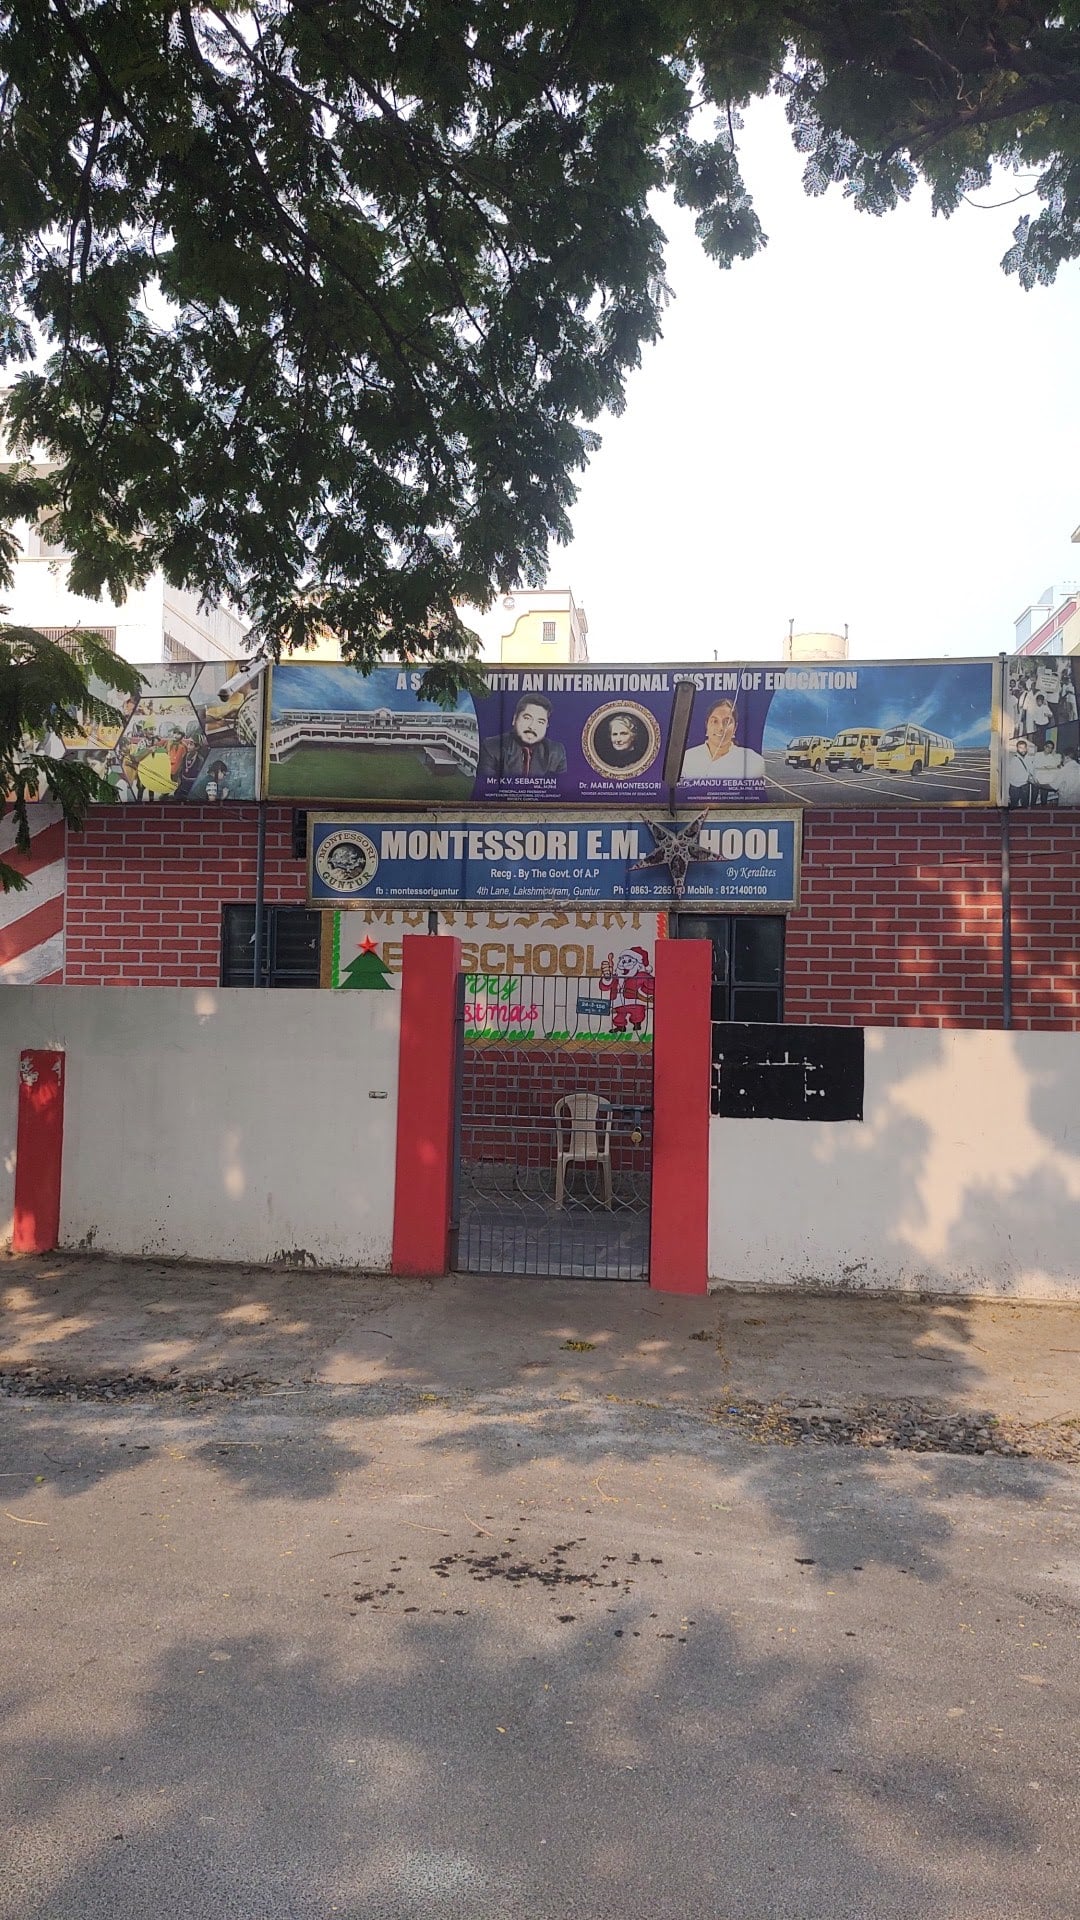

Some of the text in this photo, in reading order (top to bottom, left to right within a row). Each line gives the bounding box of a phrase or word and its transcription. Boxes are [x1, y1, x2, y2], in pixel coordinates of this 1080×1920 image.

[396, 672, 408, 690] A
[522, 673, 544, 691] AN
[548, 672, 669, 692] INTERNATIONAL
[742, 671, 762, 690] OF
[765, 671, 858, 690] EDUCATION
[693, 779, 721, 787] MANJU
[722, 779, 766, 787] SEBASTIAN
[318, 832, 376, 859] MONTESSORI
[381, 828, 784, 860] MONTESSORI E.M. HOOL
[322, 871, 373, 889] GUNTUR
[518, 868, 529, 880] By
[531, 868, 547, 878] The
[548, 868, 571, 878] Govt.
[573, 868, 583, 878] Of
[726, 866, 777, 879] By Keralites
[375, 886, 383, 895] fb
[390, 886, 459, 897] montessoriguntur
[476, 886, 489, 896] 4th
[490, 886, 511, 897] Lane,
[513, 886, 571, 898] Lakshmipuram,
[613, 885, 624, 895] Ph
[687, 885, 714, 895] Mobile
[720, 885, 767, 895] 8121400100
[460, 942, 601, 975] SCHOOL
